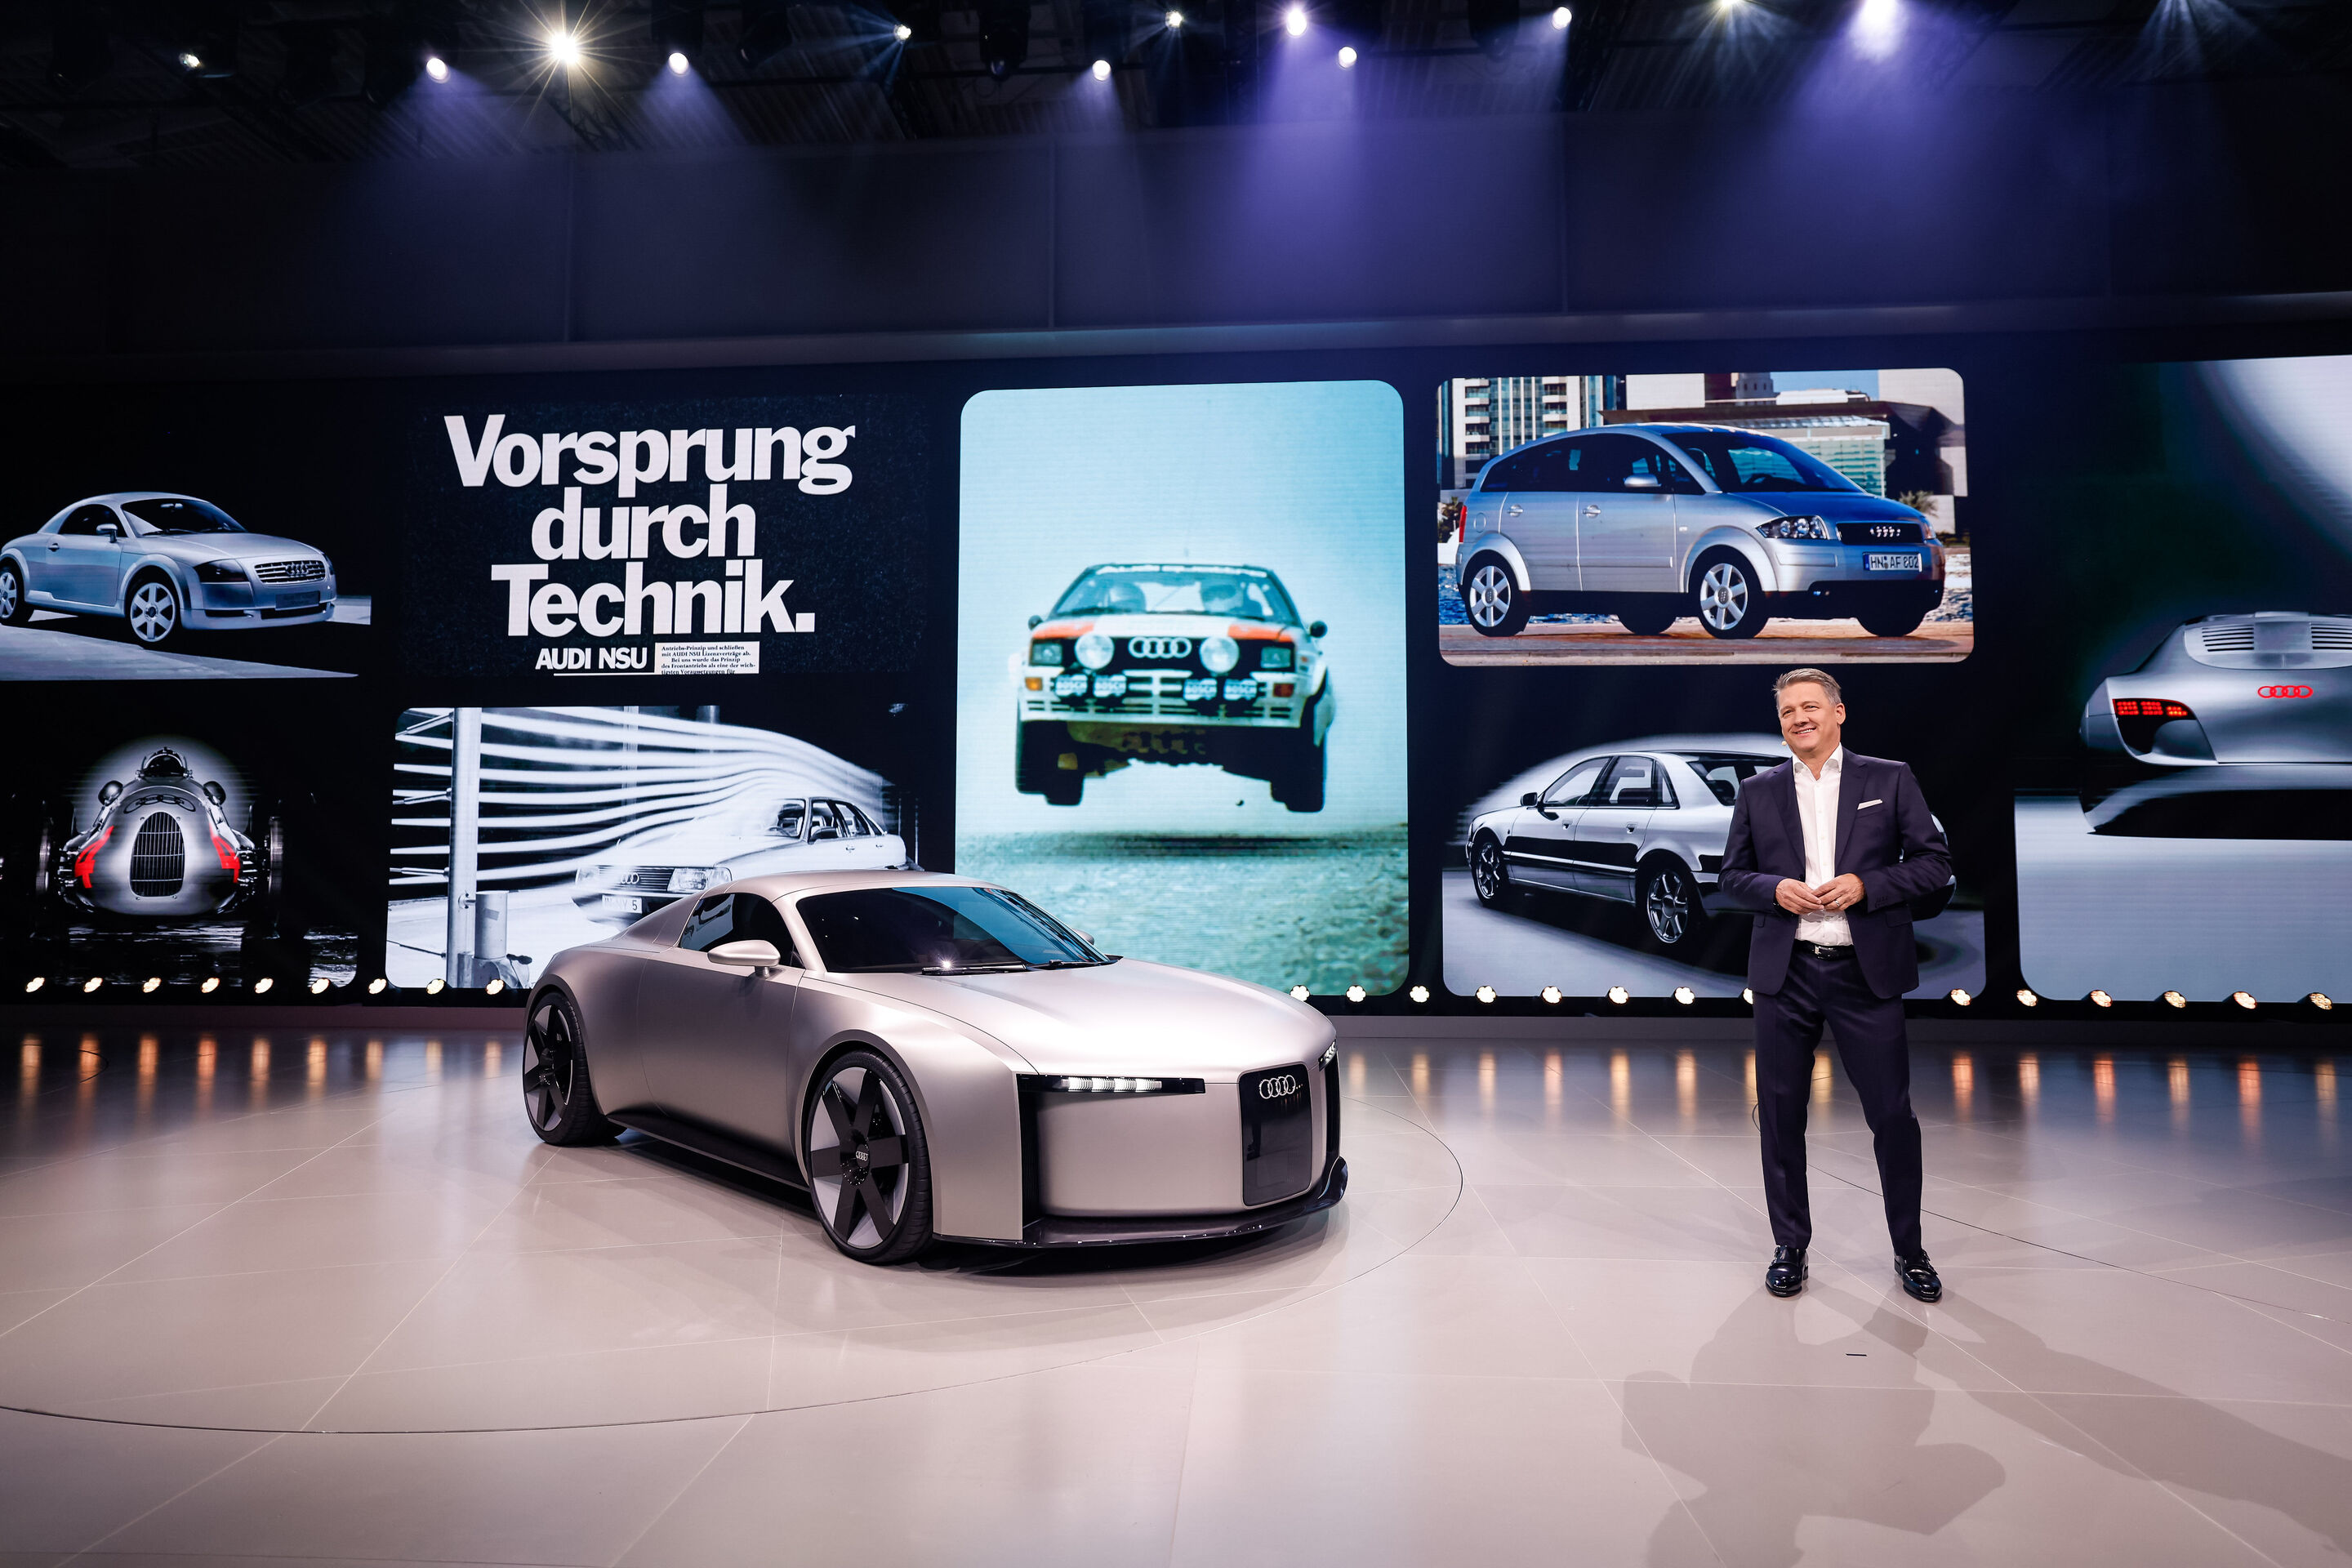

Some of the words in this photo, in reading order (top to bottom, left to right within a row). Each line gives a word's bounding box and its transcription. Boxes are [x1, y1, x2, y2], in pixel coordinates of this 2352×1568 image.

[444, 414, 856, 498] Vorsprung
[532, 483, 756, 560] durch
[492, 559, 815, 637] Technik.
[535, 648, 591, 670] AUDI
[599, 647, 648, 670] NSU
[632, 899, 638, 911] 5
